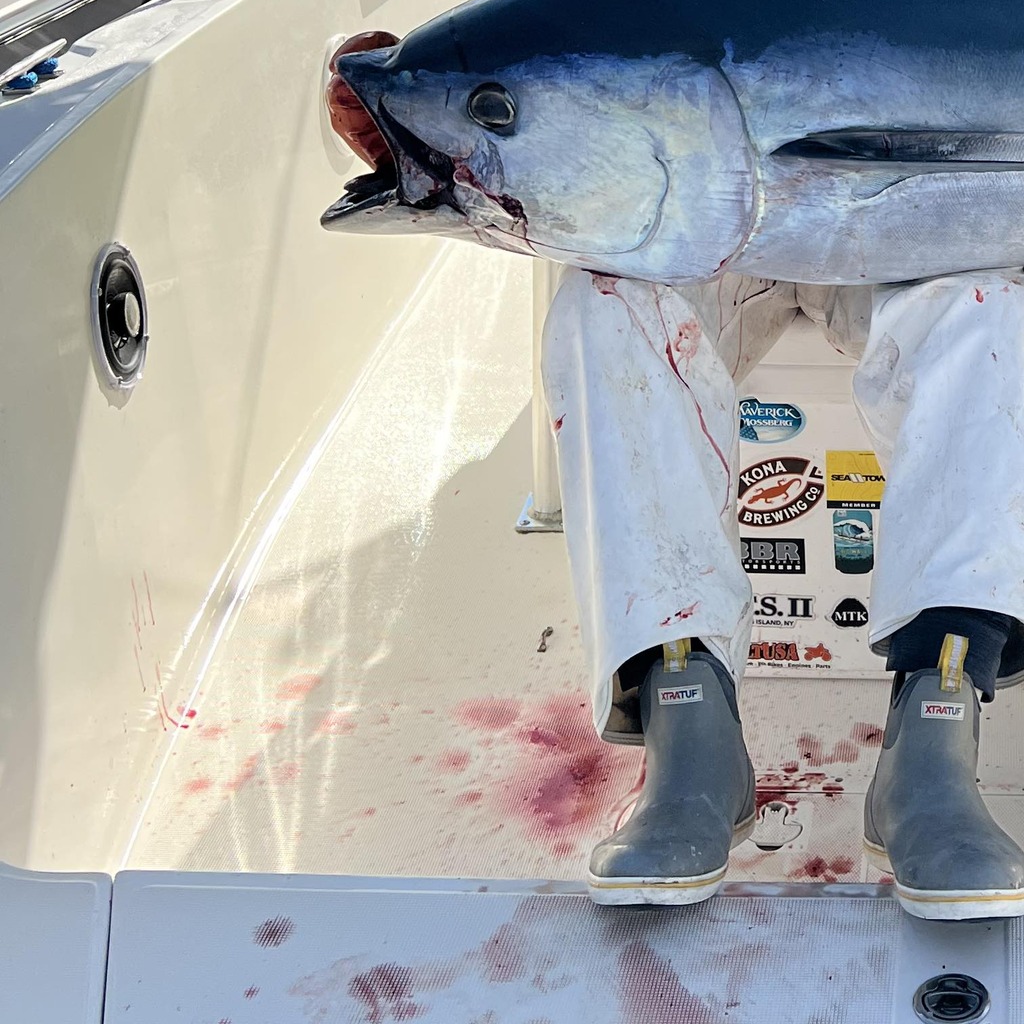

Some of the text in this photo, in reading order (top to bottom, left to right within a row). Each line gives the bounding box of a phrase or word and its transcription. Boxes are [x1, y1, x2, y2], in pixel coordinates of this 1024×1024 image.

[740, 460, 787, 487] KONA
[743, 501, 808, 525] BREWING
[834, 611, 867, 622] MTK
[756, 619, 782, 627] ISLAND,
[661, 689, 699, 700] XTRATUF
[925, 704, 963, 715] XTRATUF
